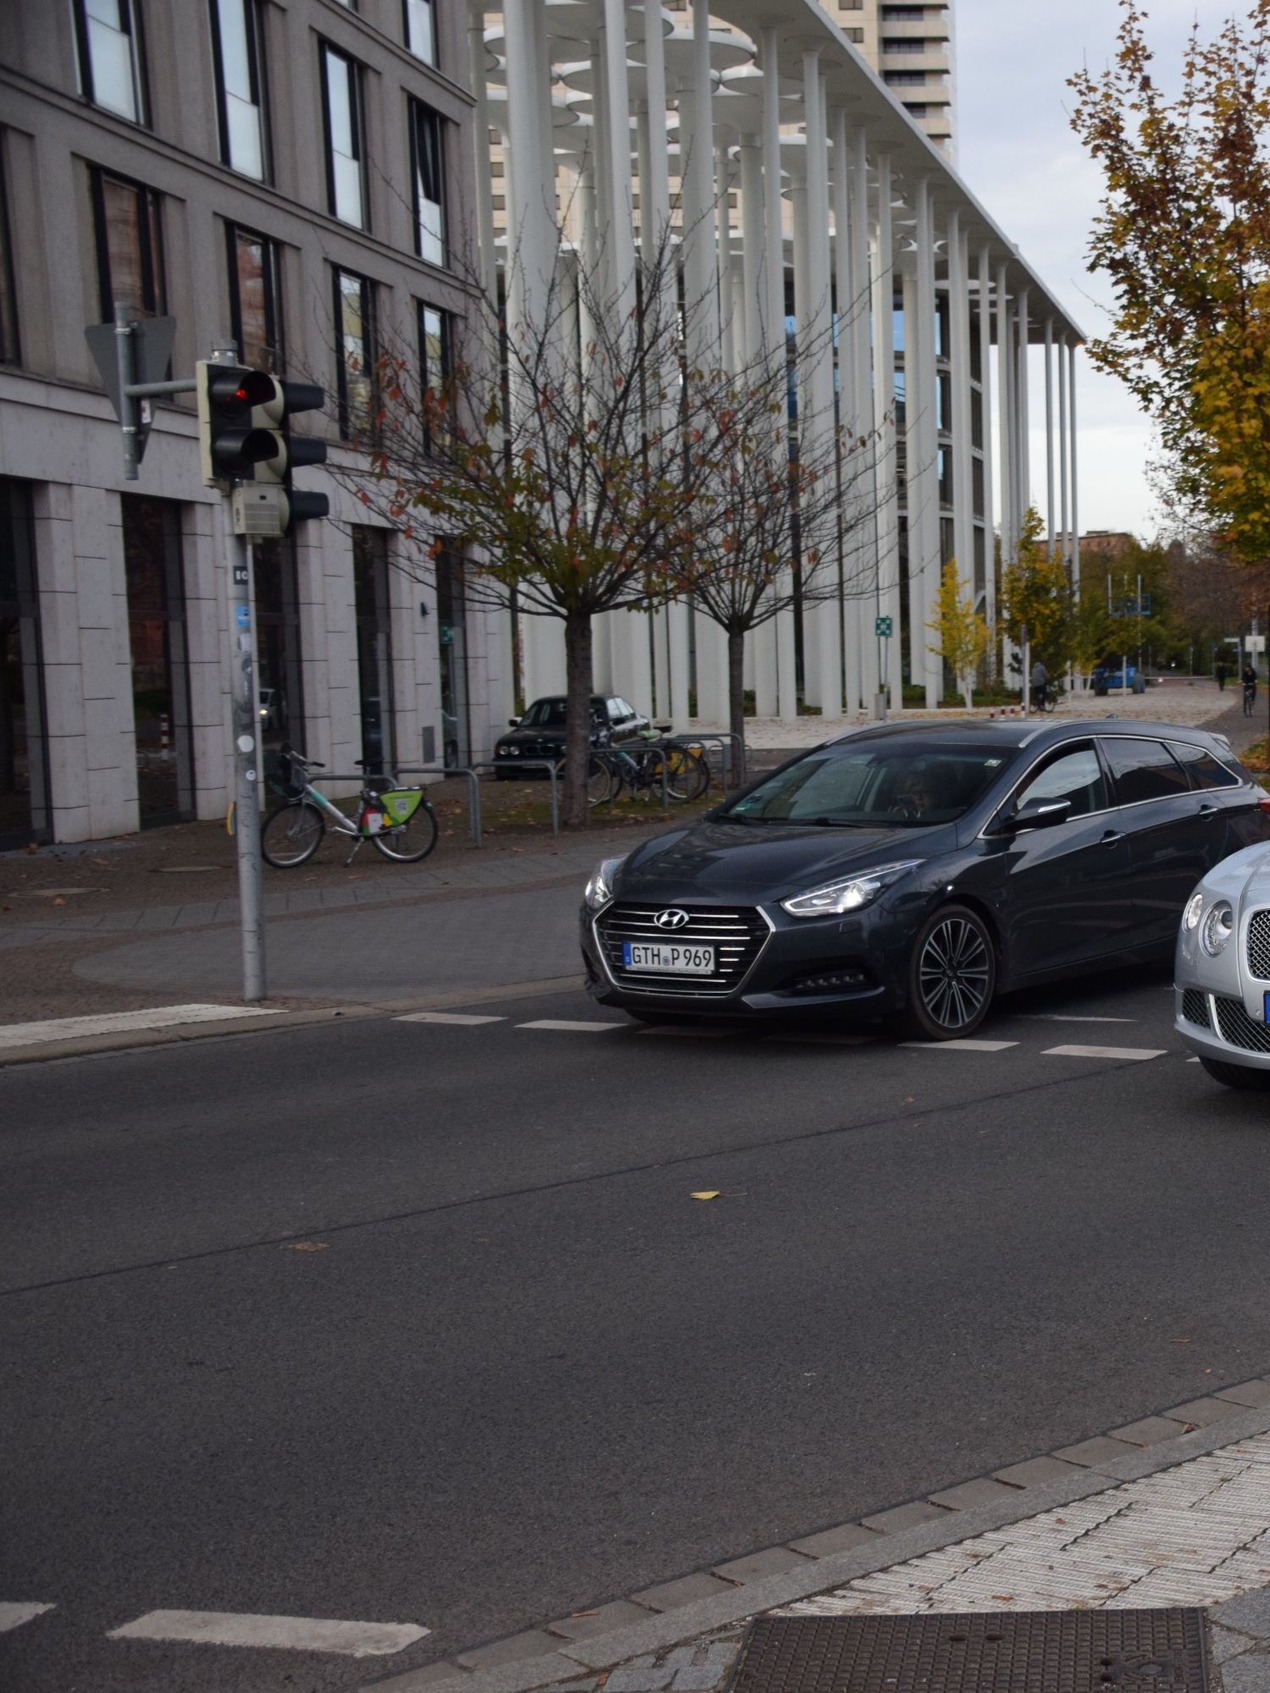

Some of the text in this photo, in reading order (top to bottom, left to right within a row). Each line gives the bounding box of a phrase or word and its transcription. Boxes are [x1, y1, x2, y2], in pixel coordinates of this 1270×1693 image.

[632, 946, 713, 968] GTH P 969
